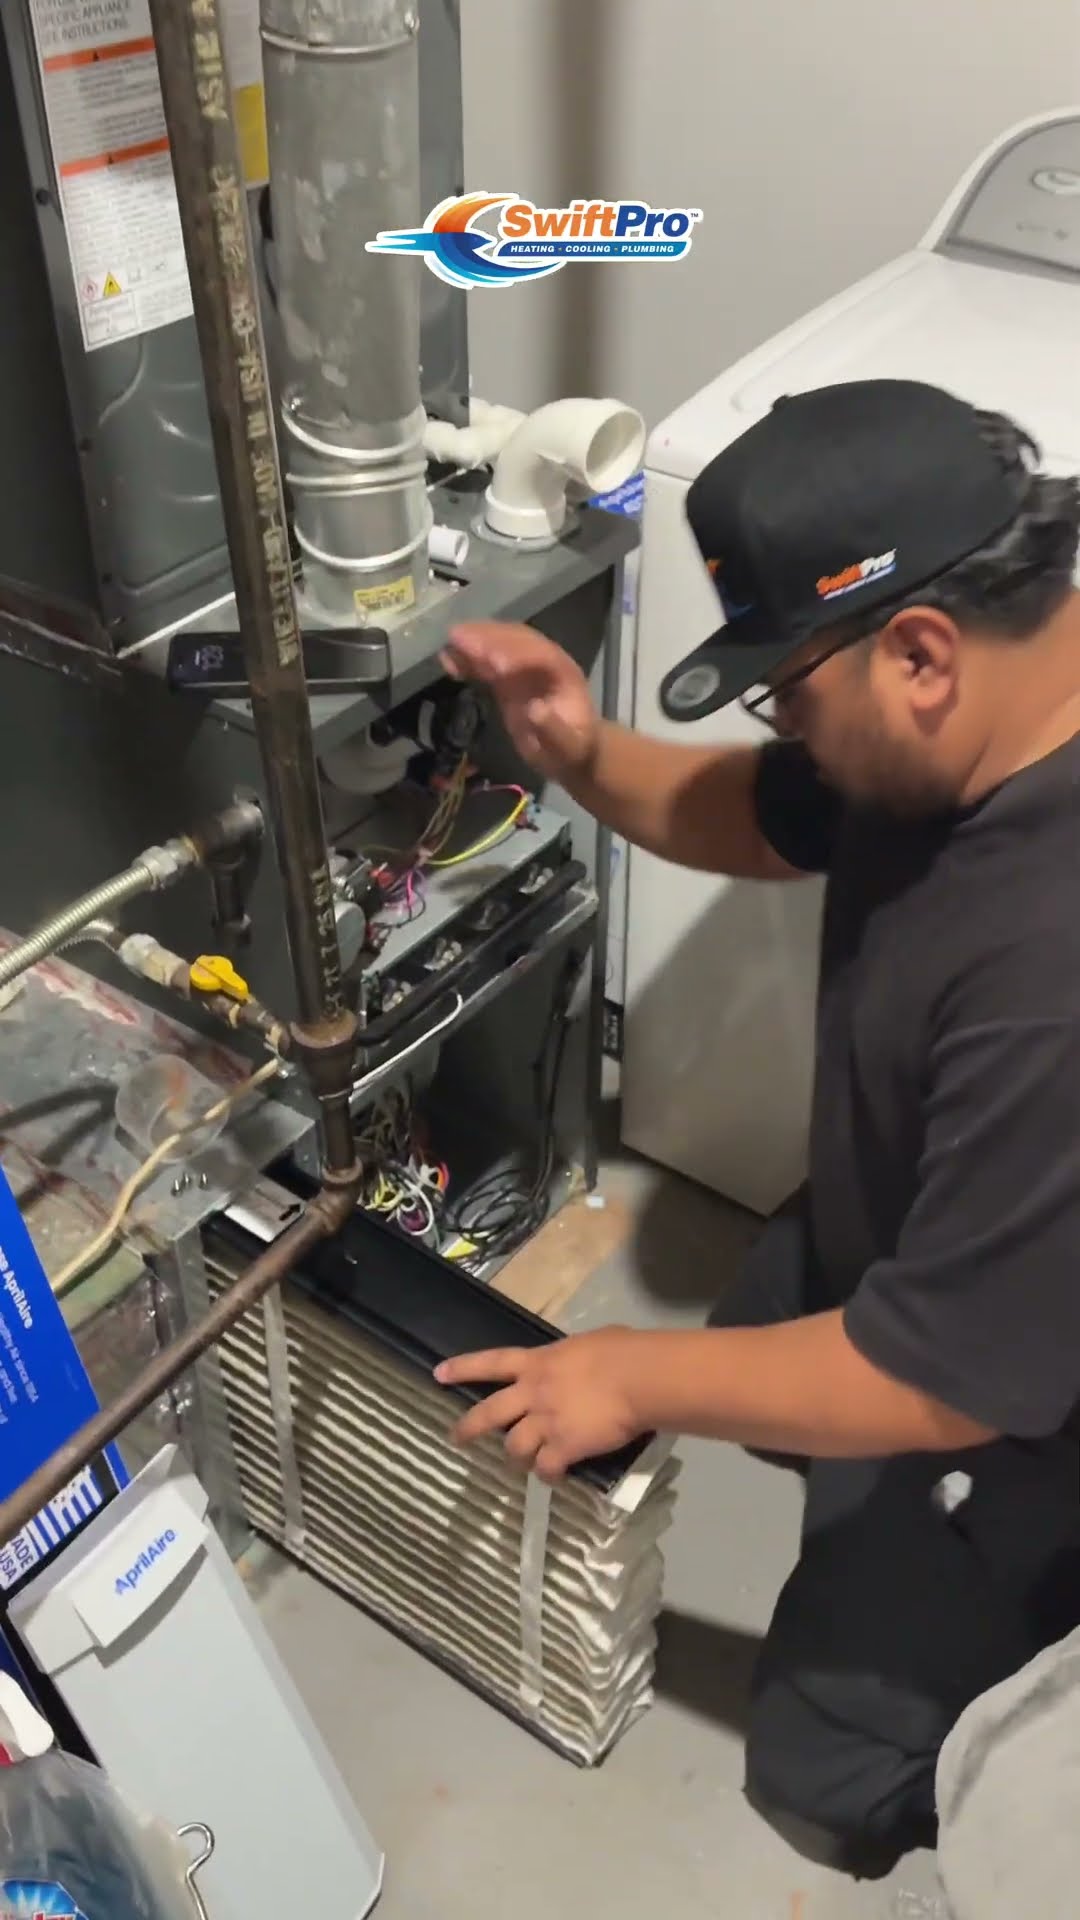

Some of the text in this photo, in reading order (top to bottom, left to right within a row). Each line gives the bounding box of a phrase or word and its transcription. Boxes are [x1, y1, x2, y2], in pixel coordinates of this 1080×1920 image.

[3, 1269, 33, 1329] AprilAire
[11, 1537, 33, 1569] ADE
[115, 1529, 176, 1596] AprilAire
